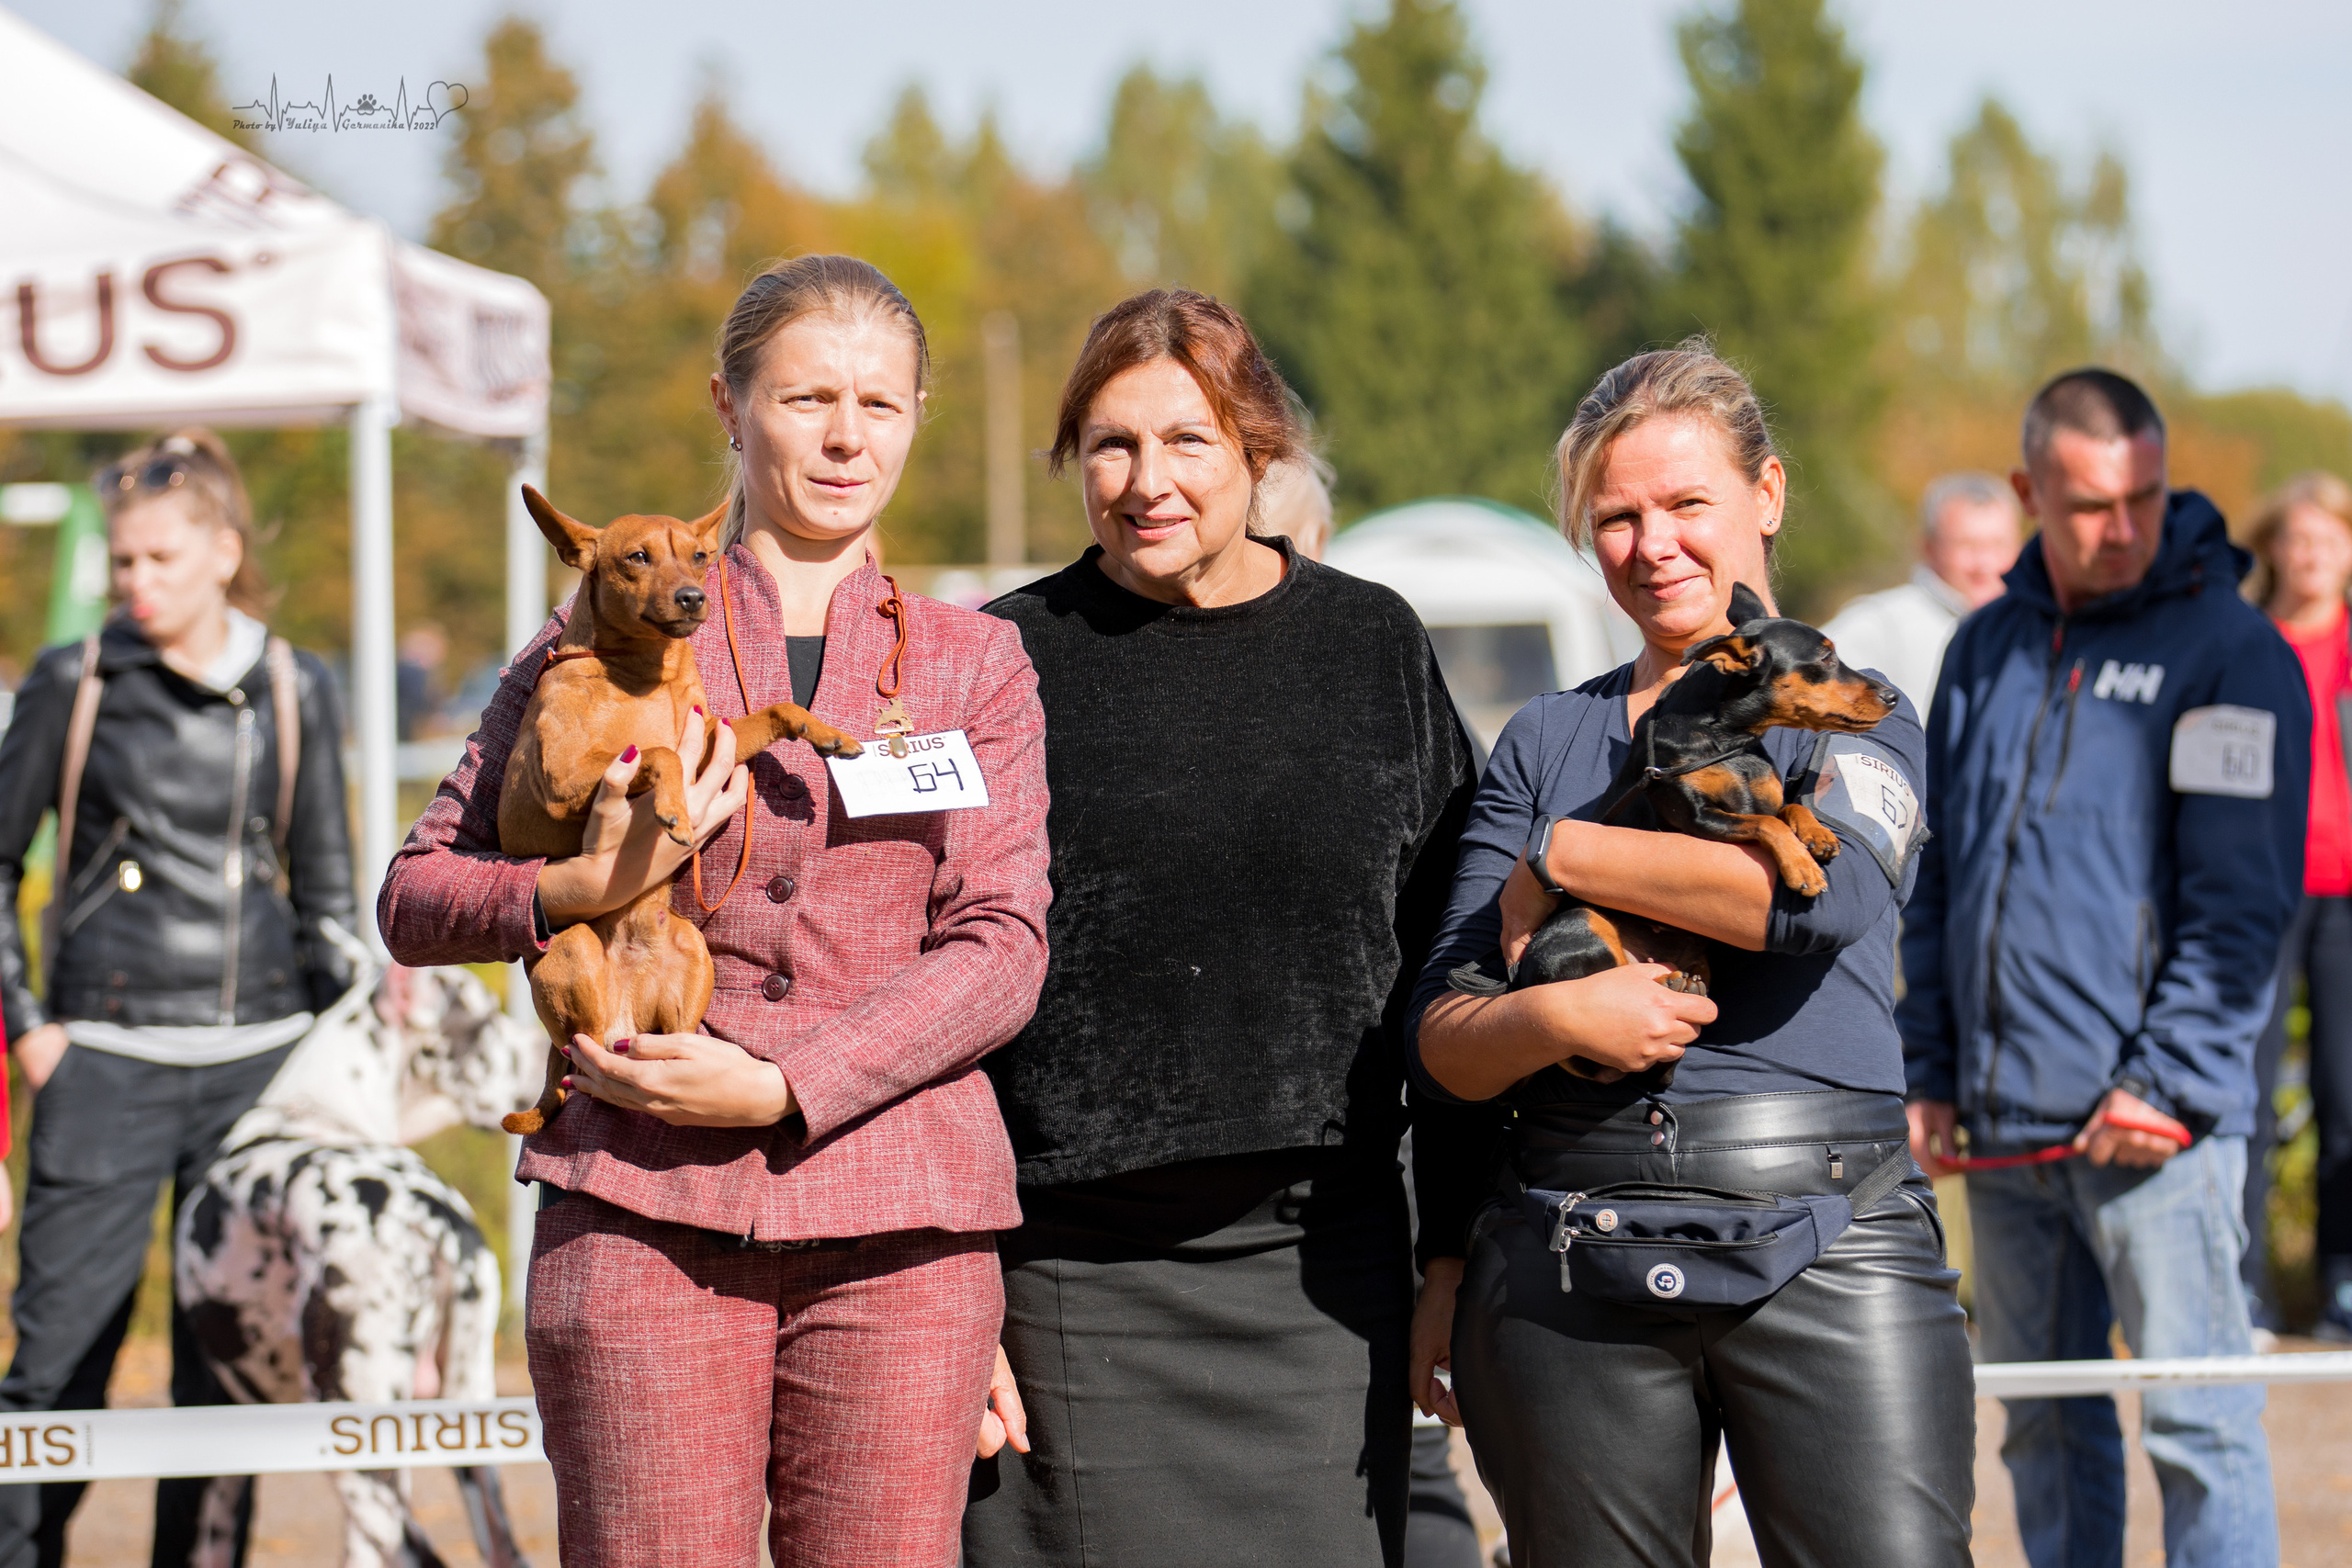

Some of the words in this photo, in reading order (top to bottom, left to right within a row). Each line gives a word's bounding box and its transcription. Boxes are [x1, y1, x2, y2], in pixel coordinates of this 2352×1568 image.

[908, 758, 964, 794] 64
[1860, 756, 1910, 796] SIRIUS
[331, 1409, 529, 1455] SIRIUS
